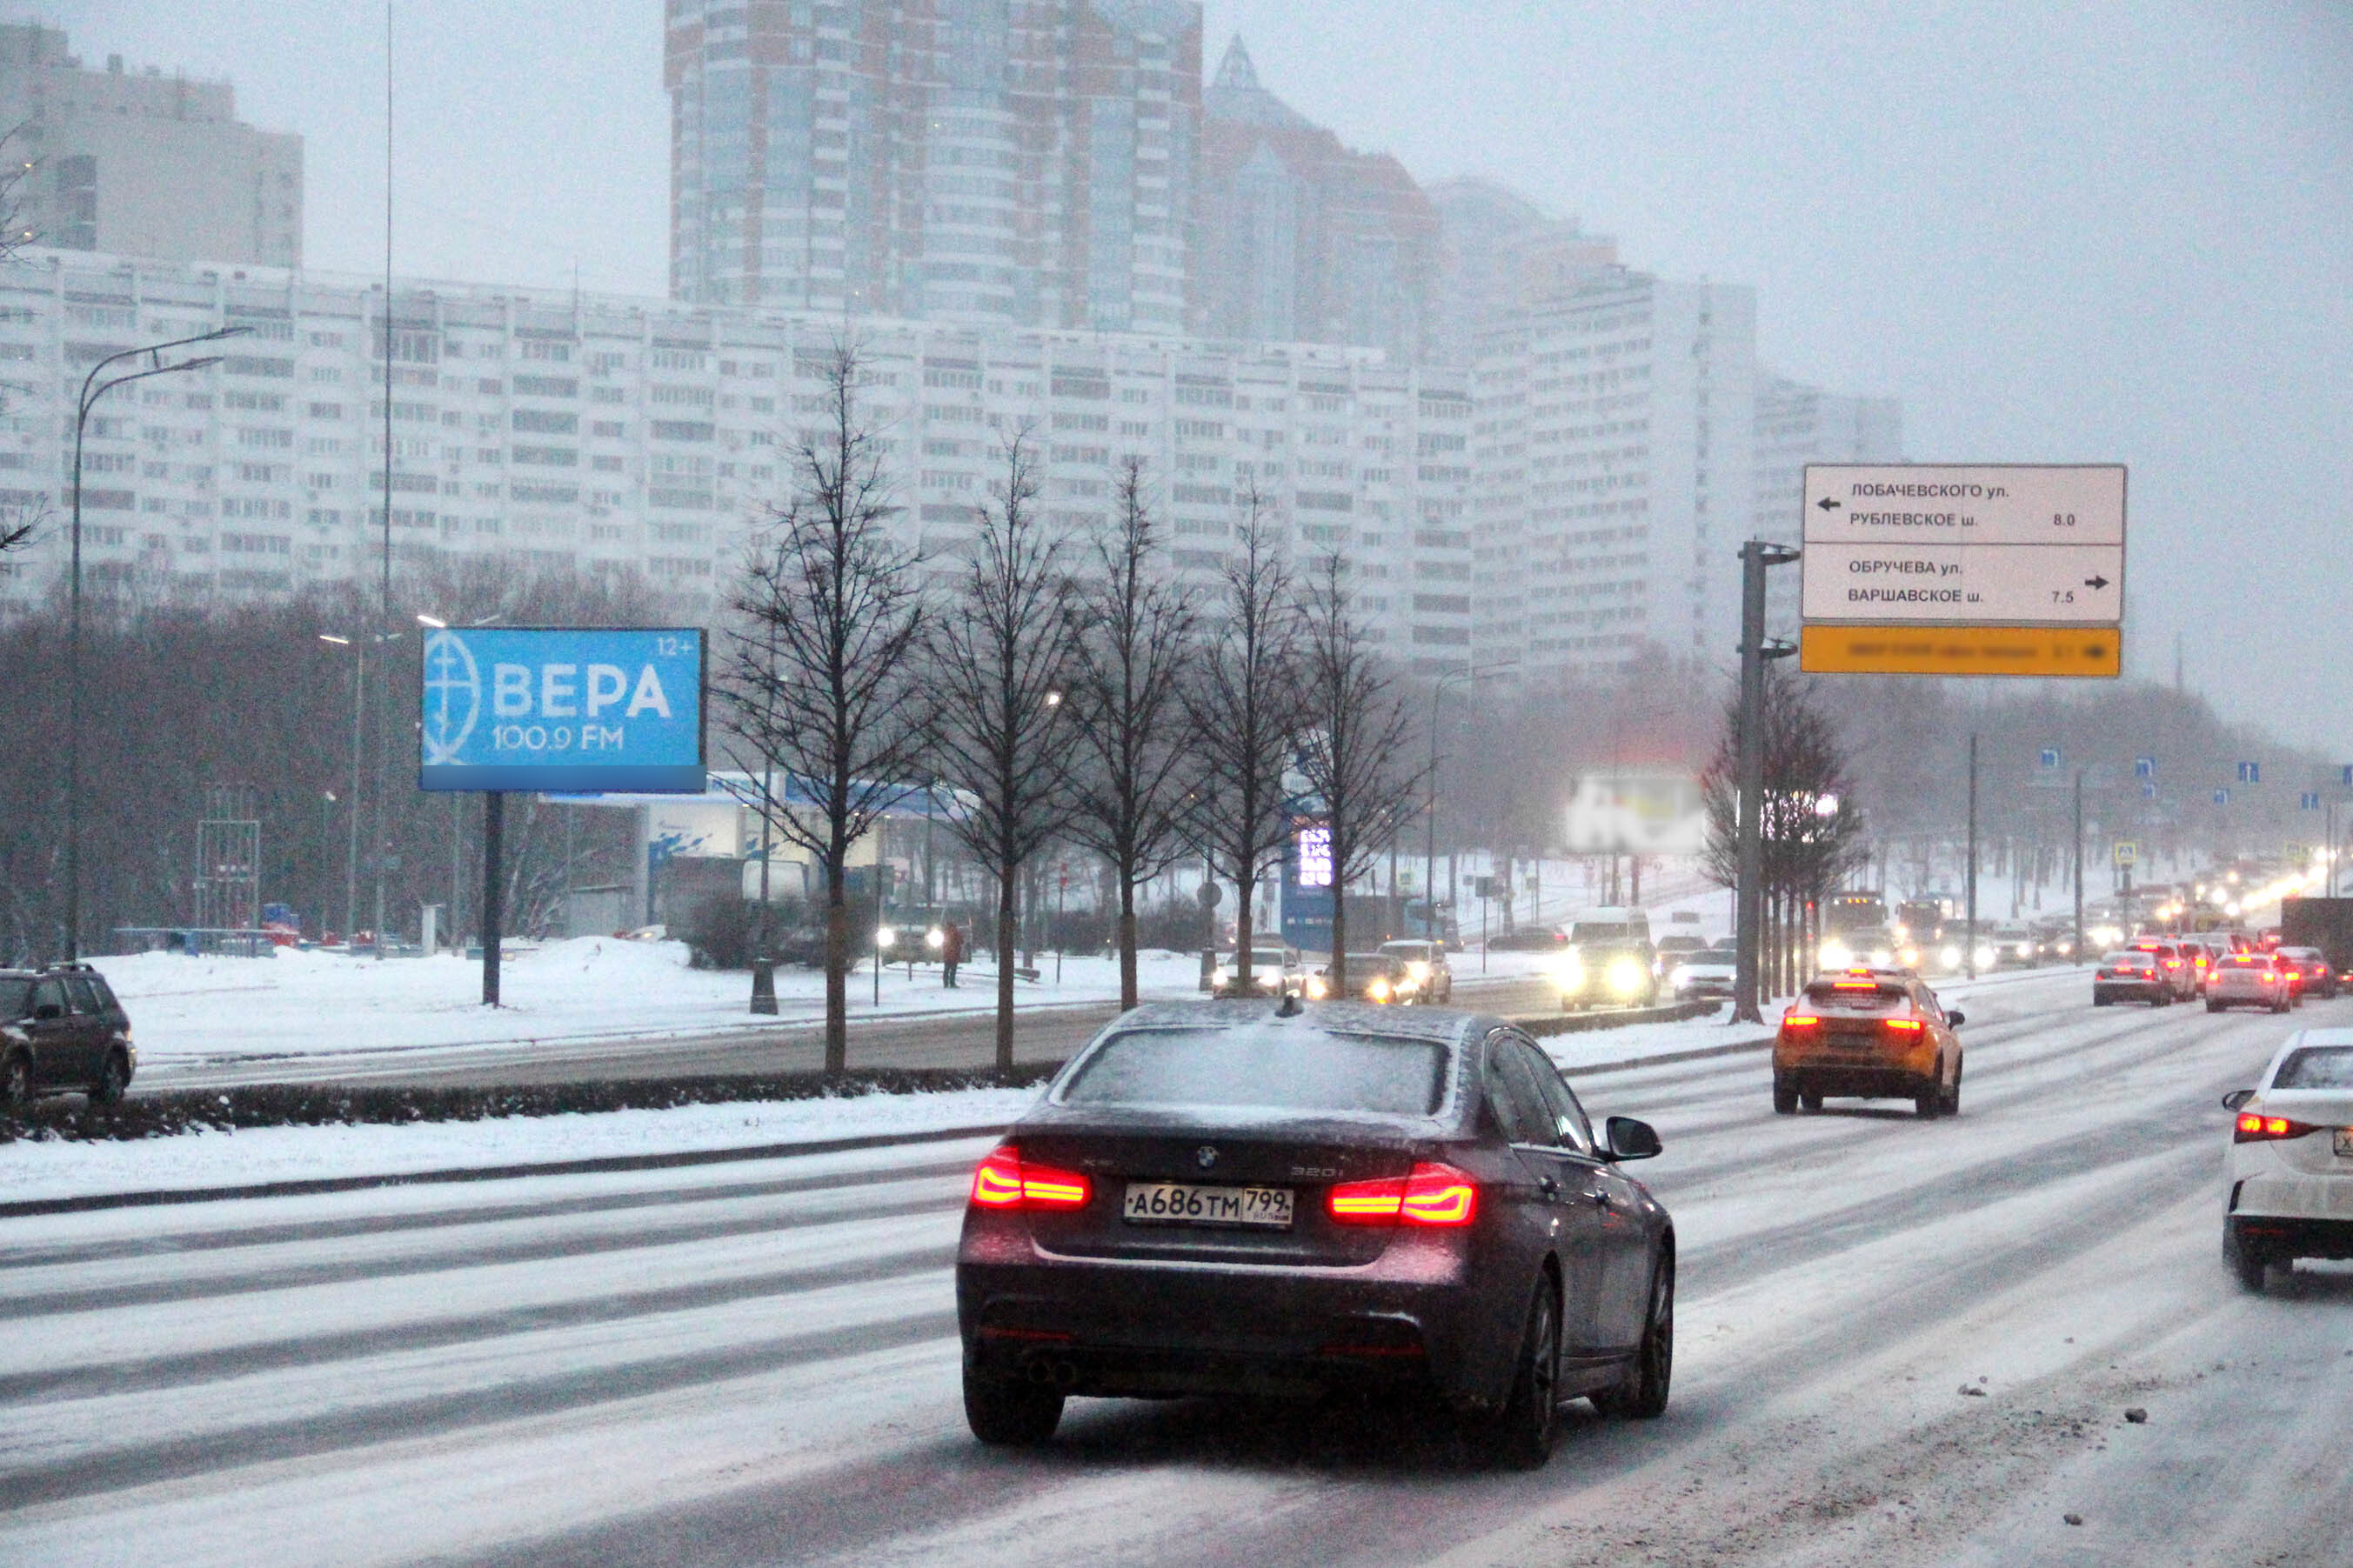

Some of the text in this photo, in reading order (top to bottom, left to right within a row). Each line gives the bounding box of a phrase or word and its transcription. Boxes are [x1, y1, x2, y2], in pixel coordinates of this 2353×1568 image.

[1852, 484, 2009, 500] ЛОБАЧЕВСКОГО ул.
[1850, 513, 1978, 526] РУБЛЕВСКОЕ ш.
[2053, 513, 2076, 526] 8.0
[1849, 561, 1962, 577] ОБРУЧЕВА ул.
[1848, 590, 1983, 603] ВАРШАВСКОЕ ш.
[2052, 591, 2074, 604] 7.5
[658, 637, 694, 656] 12+
[493, 664, 672, 717] ВЕРА
[493, 725, 624, 751] 100.9 FM
[1246, 1190, 1286, 1211] 799
